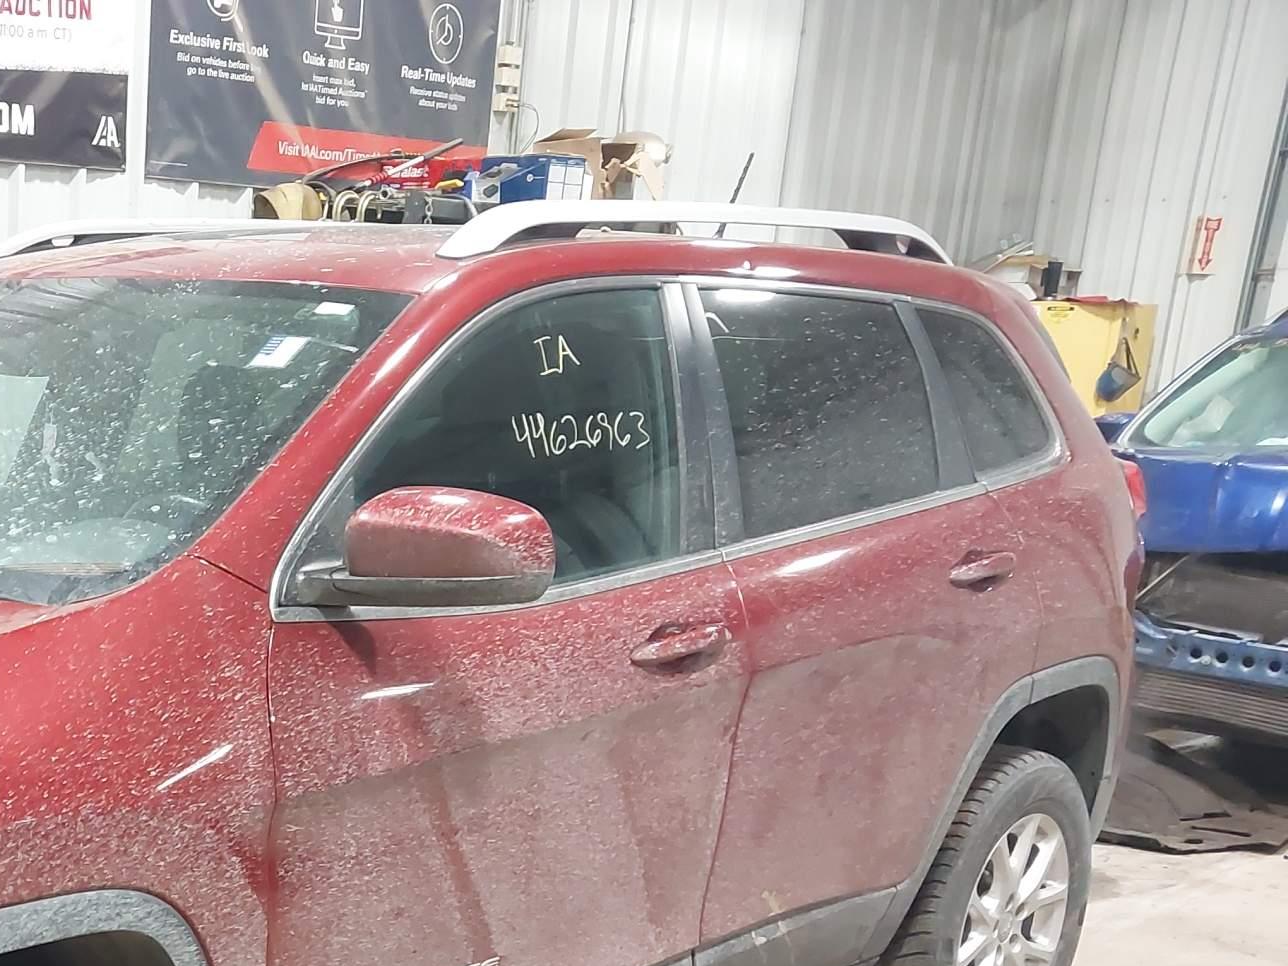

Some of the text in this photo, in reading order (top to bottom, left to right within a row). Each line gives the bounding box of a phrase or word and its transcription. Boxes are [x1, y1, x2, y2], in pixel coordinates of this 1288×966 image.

[169, 29, 221, 50] Exclusive
[176, 52, 191, 62] Bid
[190, 55, 201, 64] on
[228, 59, 250, 71] before
[302, 50, 370, 76] Quick and Easy
[186, 66, 197, 76] go
[197, 67, 206, 76] to
[206, 68, 218, 77] the
[230, 72, 255, 83] auction
[400, 64, 477, 89] Real-Time Updates
[278, 141, 300, 157] Visit
[511, 411, 650, 458] 44626963
